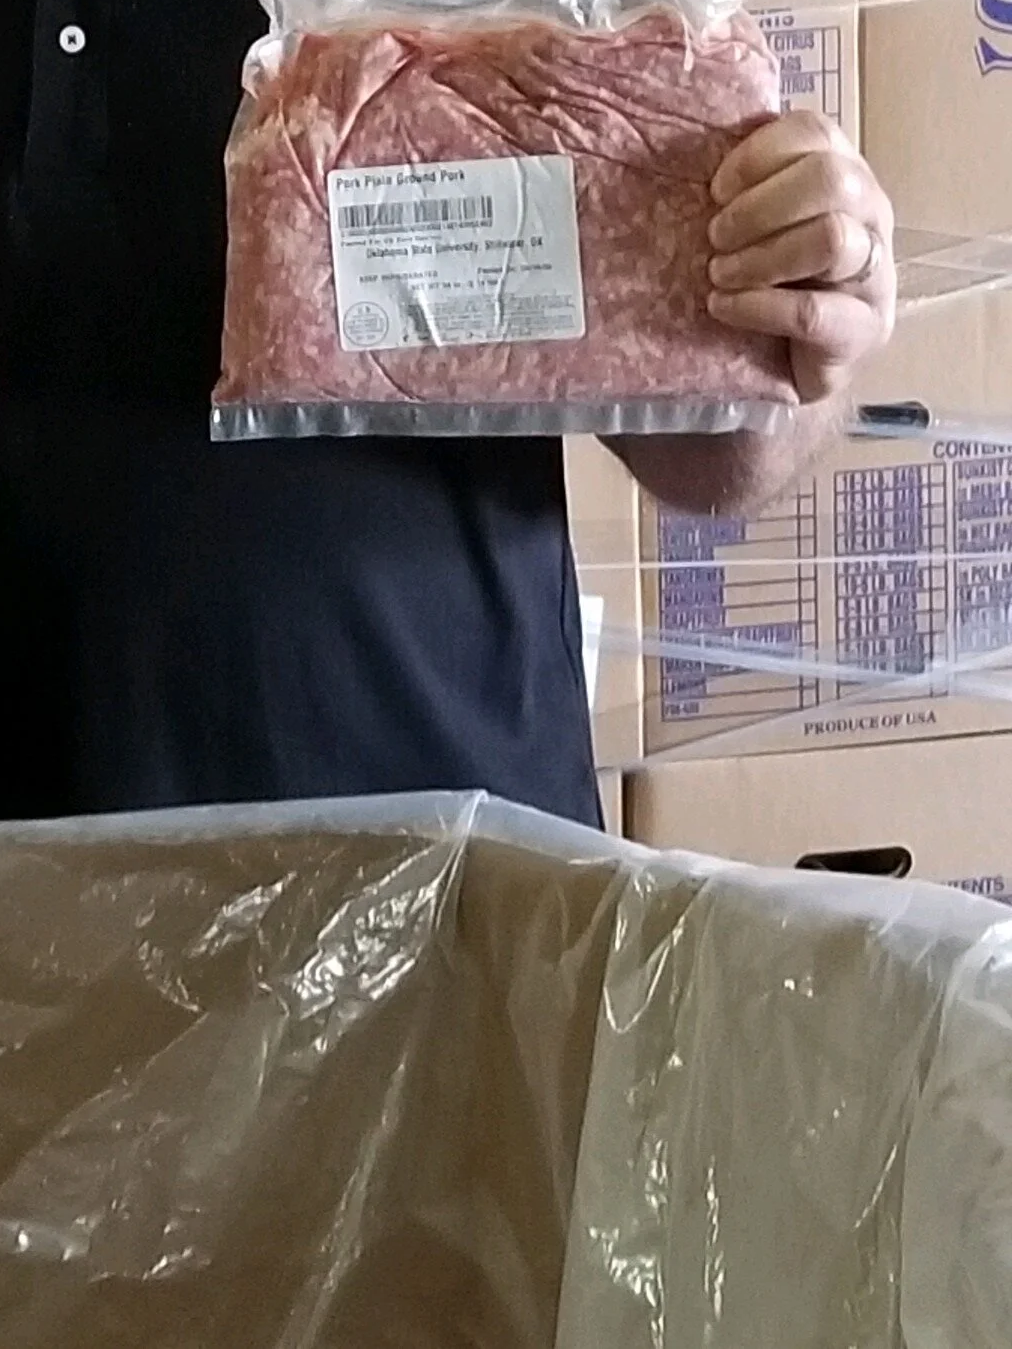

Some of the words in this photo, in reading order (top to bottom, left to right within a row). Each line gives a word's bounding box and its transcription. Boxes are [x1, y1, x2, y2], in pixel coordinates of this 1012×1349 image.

[774, 31, 814, 50] CITRUS
[780, 74, 814, 93] ITRUS
[336, 178, 360, 190] Pork
[365, 174, 392, 187] Plain
[397, 171, 435, 186] Ground
[440, 169, 465, 182] Pork
[803, 716, 881, 736] PRODUCE
[881, 713, 905, 729] OF
[906, 710, 938, 725] USA
